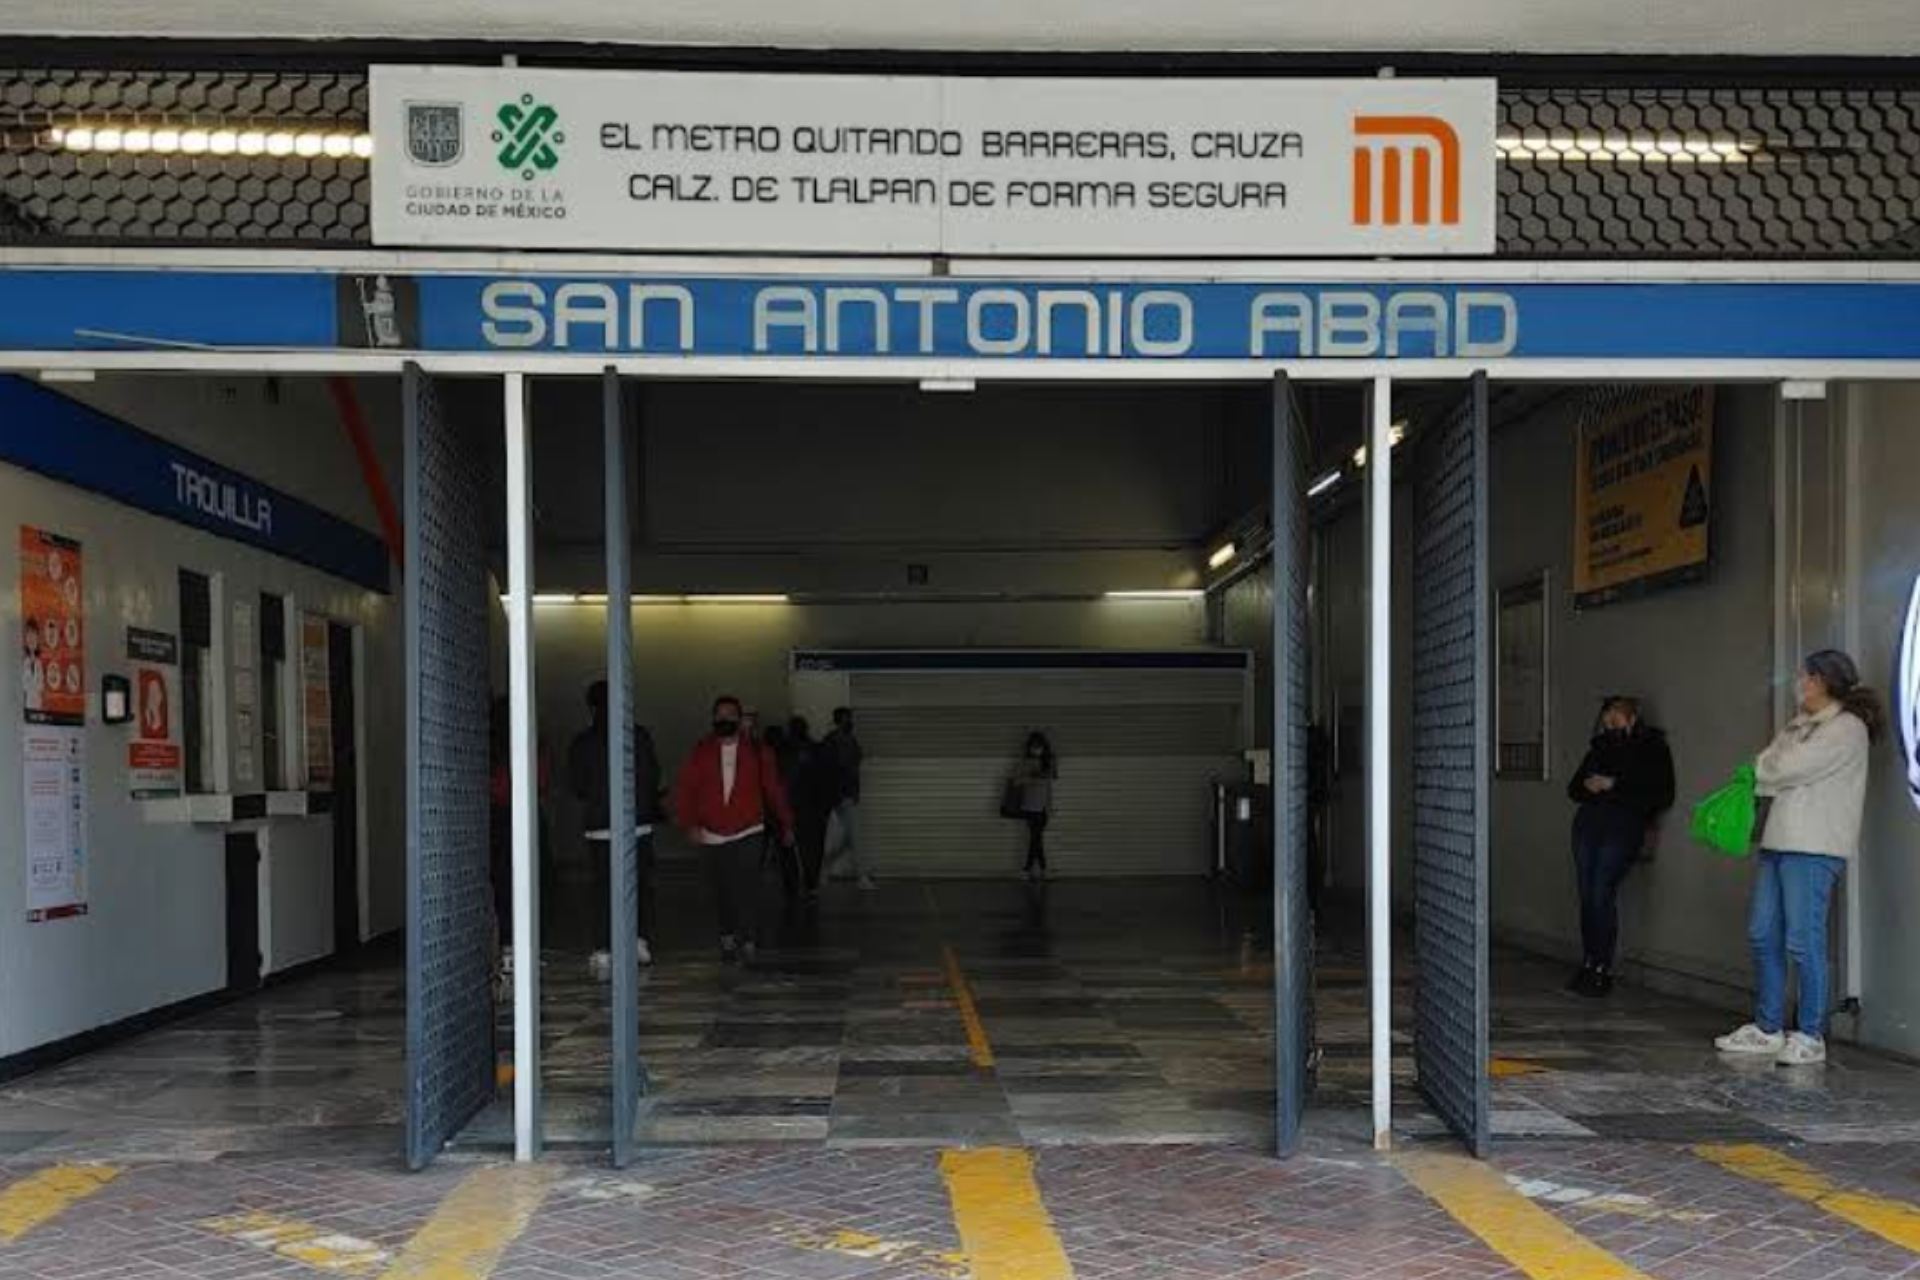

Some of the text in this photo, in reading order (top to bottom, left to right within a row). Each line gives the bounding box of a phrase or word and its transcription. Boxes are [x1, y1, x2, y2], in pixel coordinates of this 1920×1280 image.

[600, 122, 1303, 161] EL METRO QUITANDO BARRERAS, CRUZA
[406, 185, 564, 202] GOBIERNO DE LA
[628, 173, 1287, 208] CALZ. DE TLALPAN DE FORMA SEGURA
[405, 202, 566, 219] CIUDAD DE MÉXICO
[481, 282, 1518, 357] SAN ANTONIO ABAD
[171, 461, 272, 535] TAQUILLA
